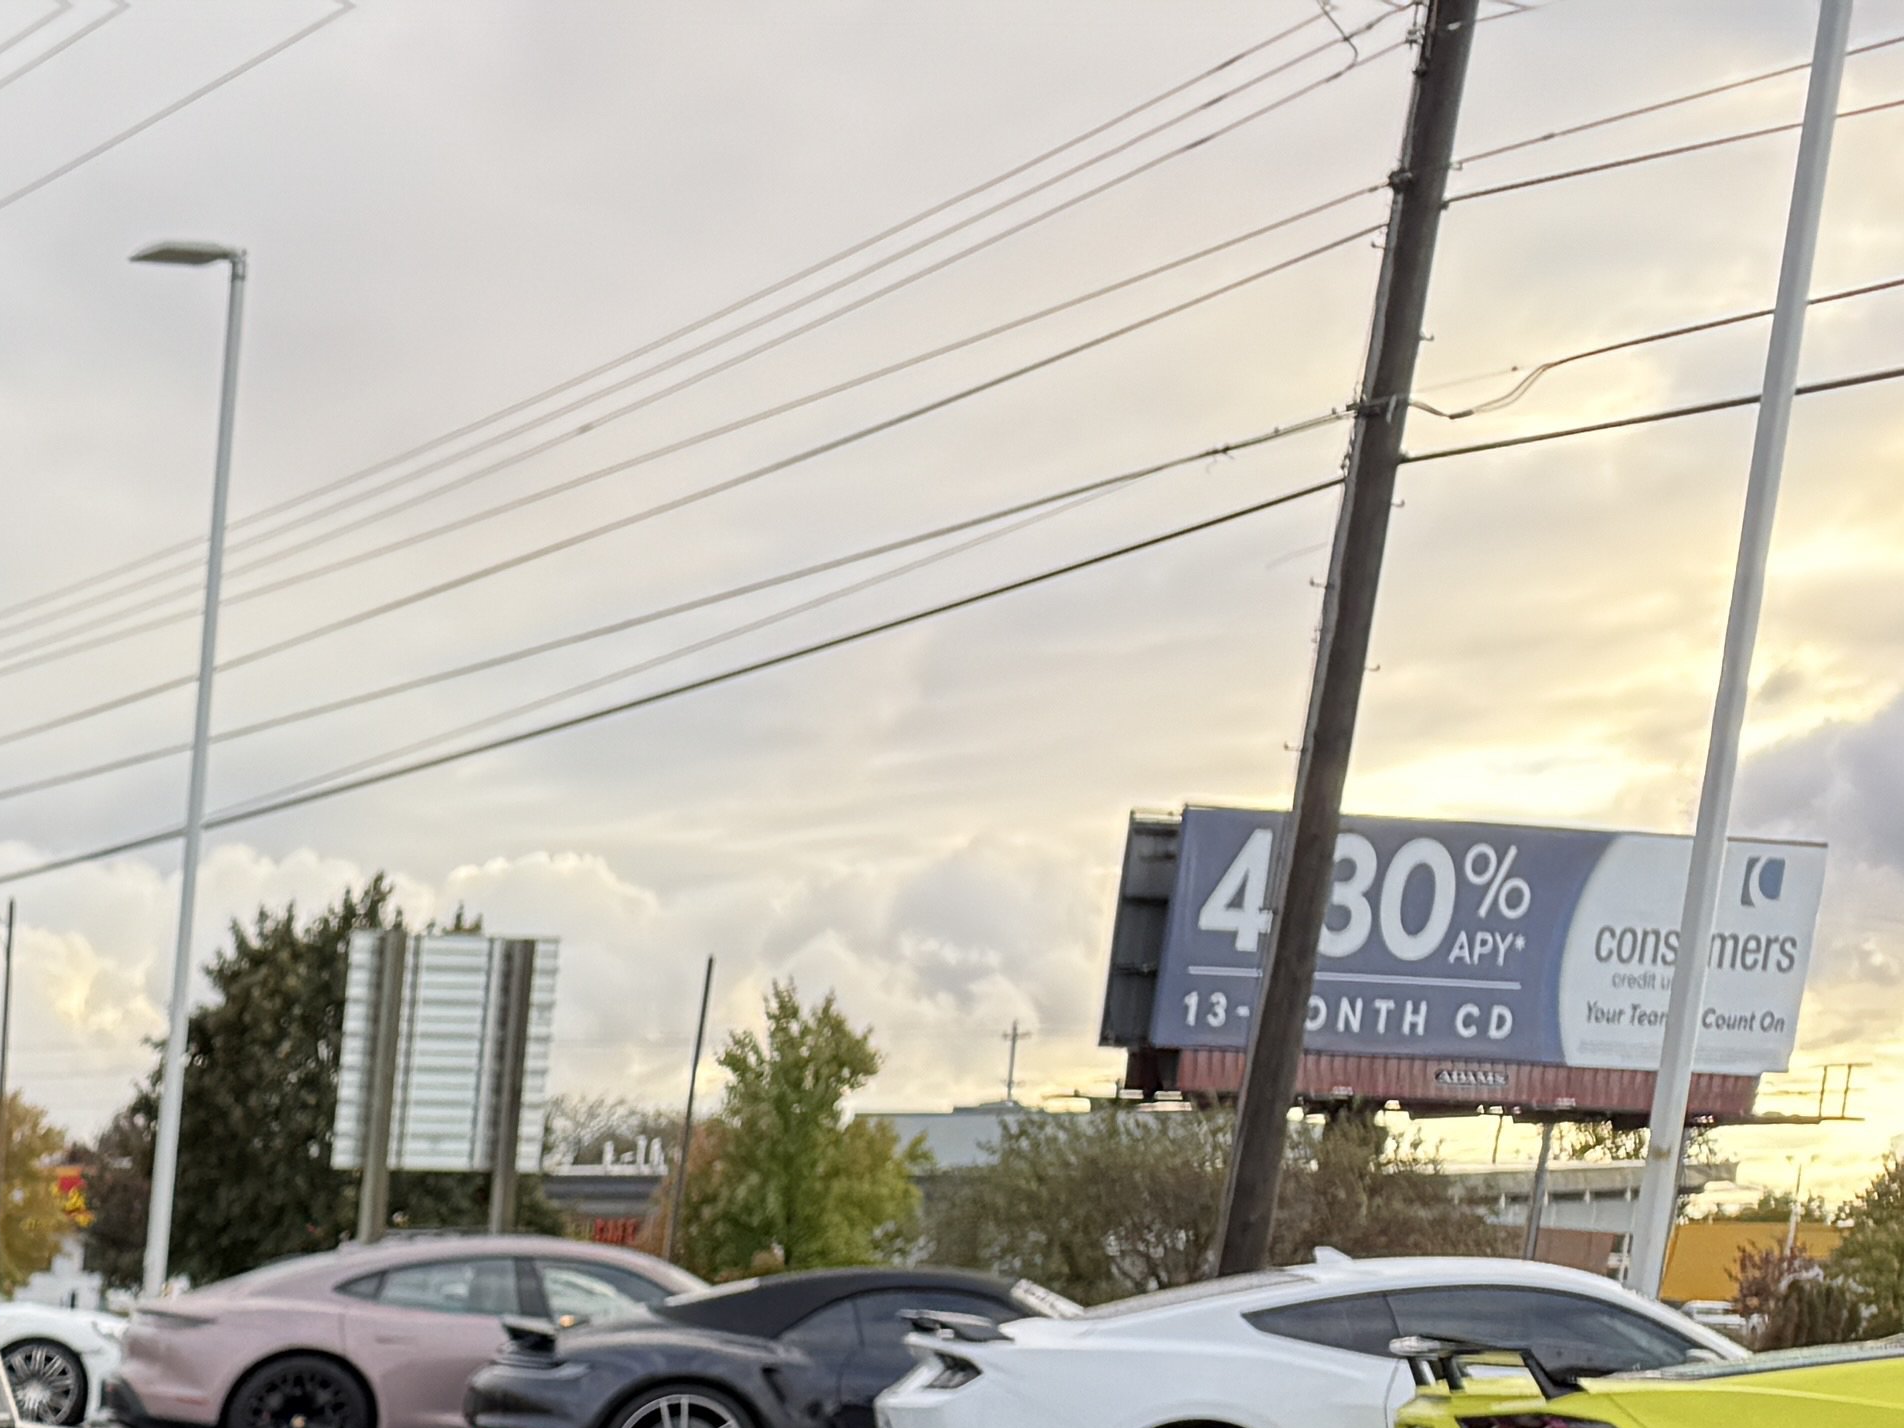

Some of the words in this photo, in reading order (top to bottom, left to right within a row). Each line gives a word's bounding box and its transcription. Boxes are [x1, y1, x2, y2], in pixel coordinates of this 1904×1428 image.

[1198, 828, 1531, 961] 430%
[1594, 925, 1798, 973] consmers
[1184, 991, 1428, 1035] 13-ONTH
[1455, 1003, 1513, 1039] CD
[1586, 1001, 1624, 1025] Your
[1702, 1007, 1755, 1031] Count
[1759, 1010, 1786, 1033] On
